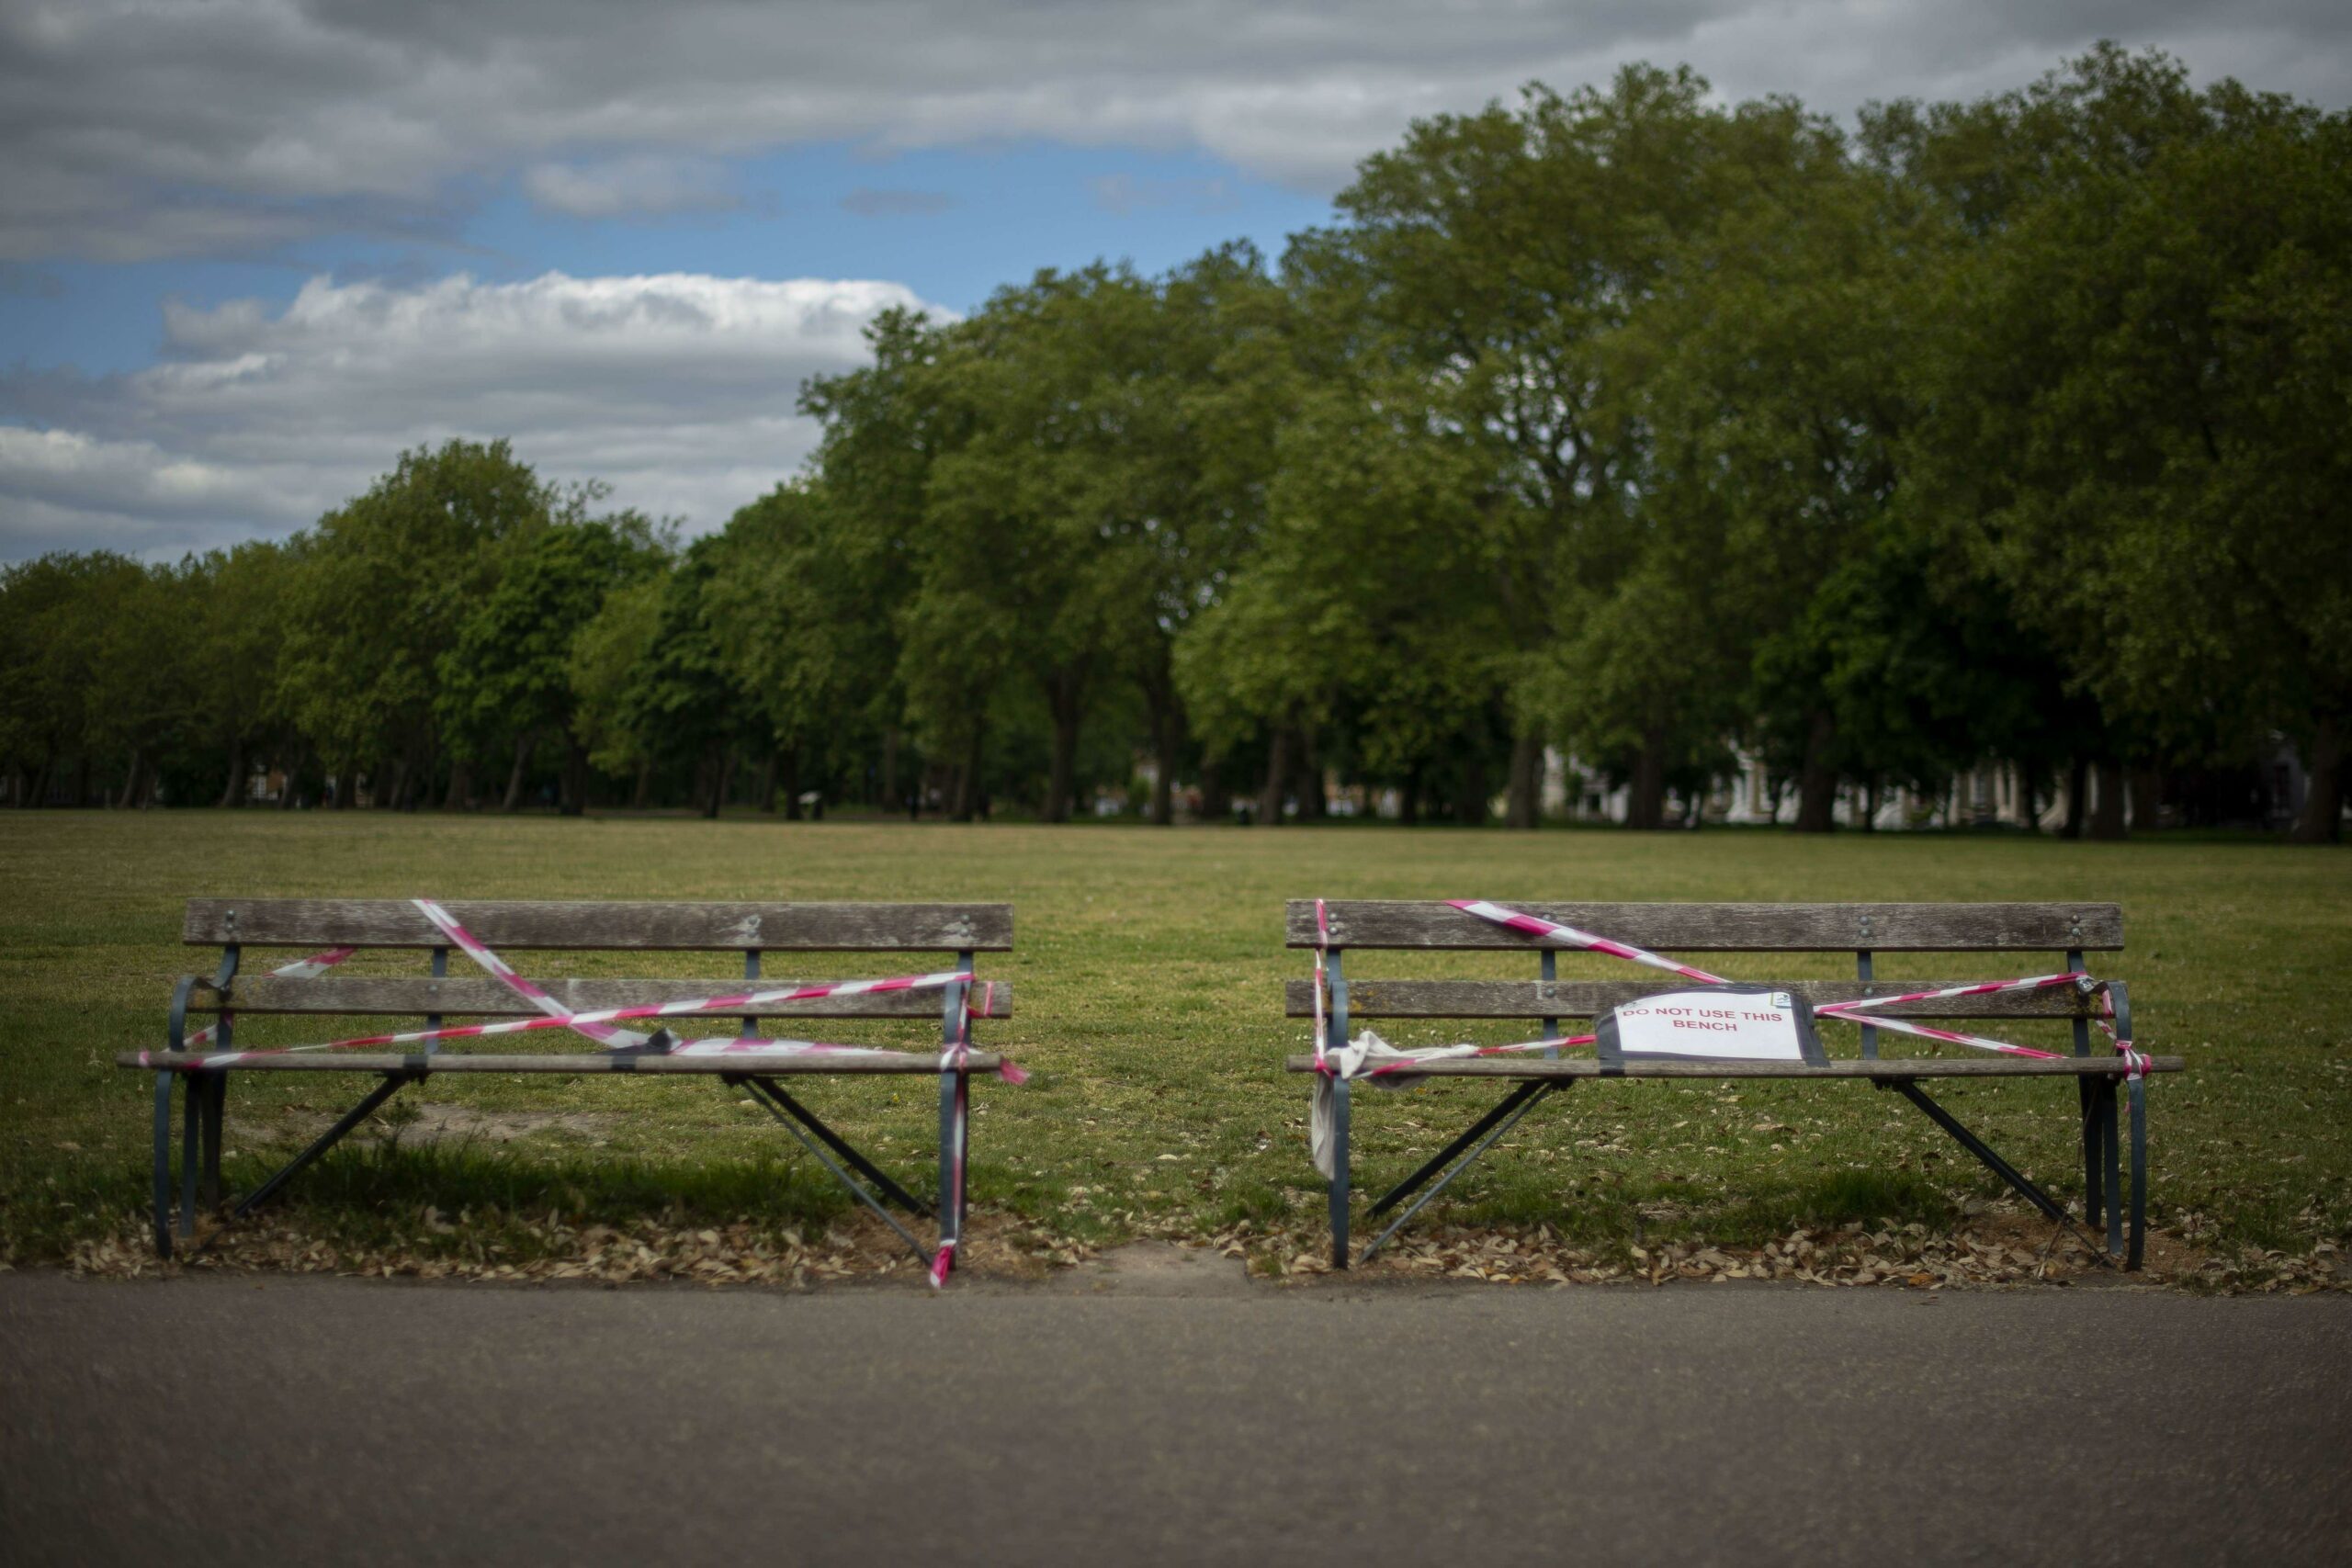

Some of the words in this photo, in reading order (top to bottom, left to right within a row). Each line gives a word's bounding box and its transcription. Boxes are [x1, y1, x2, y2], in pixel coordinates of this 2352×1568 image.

[1623, 1009, 1649, 1017] DO
[1656, 1008, 1692, 1017] NOT
[1699, 1010, 1736, 1019] USE
[1741, 1012, 1782, 1021] THIS
[1673, 1020, 1737, 1032] BENCH
